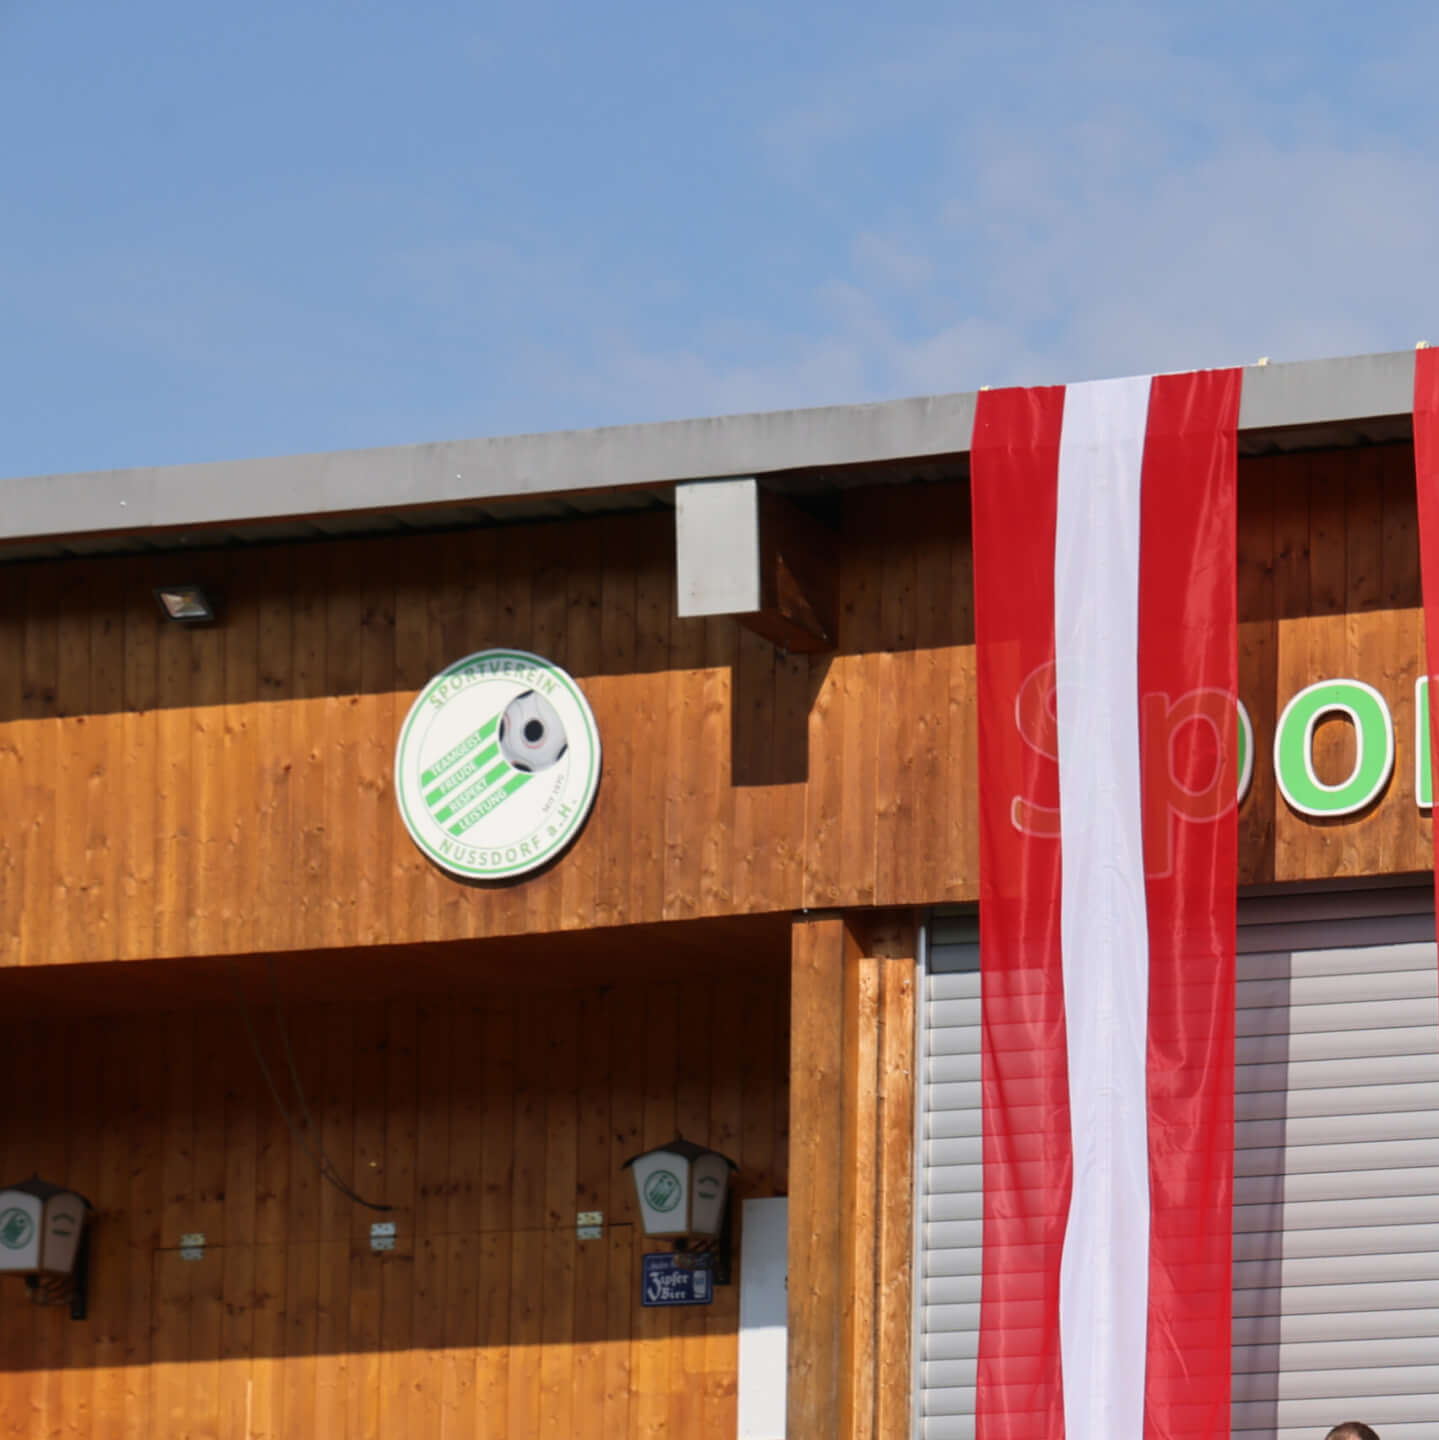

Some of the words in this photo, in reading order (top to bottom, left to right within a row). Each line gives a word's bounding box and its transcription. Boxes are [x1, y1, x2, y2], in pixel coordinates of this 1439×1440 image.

[430, 660, 557, 711] SPORTVEREIN
[459, 790, 507, 831] LEISTUNG
[440, 836, 542, 867] NUSSDORF
